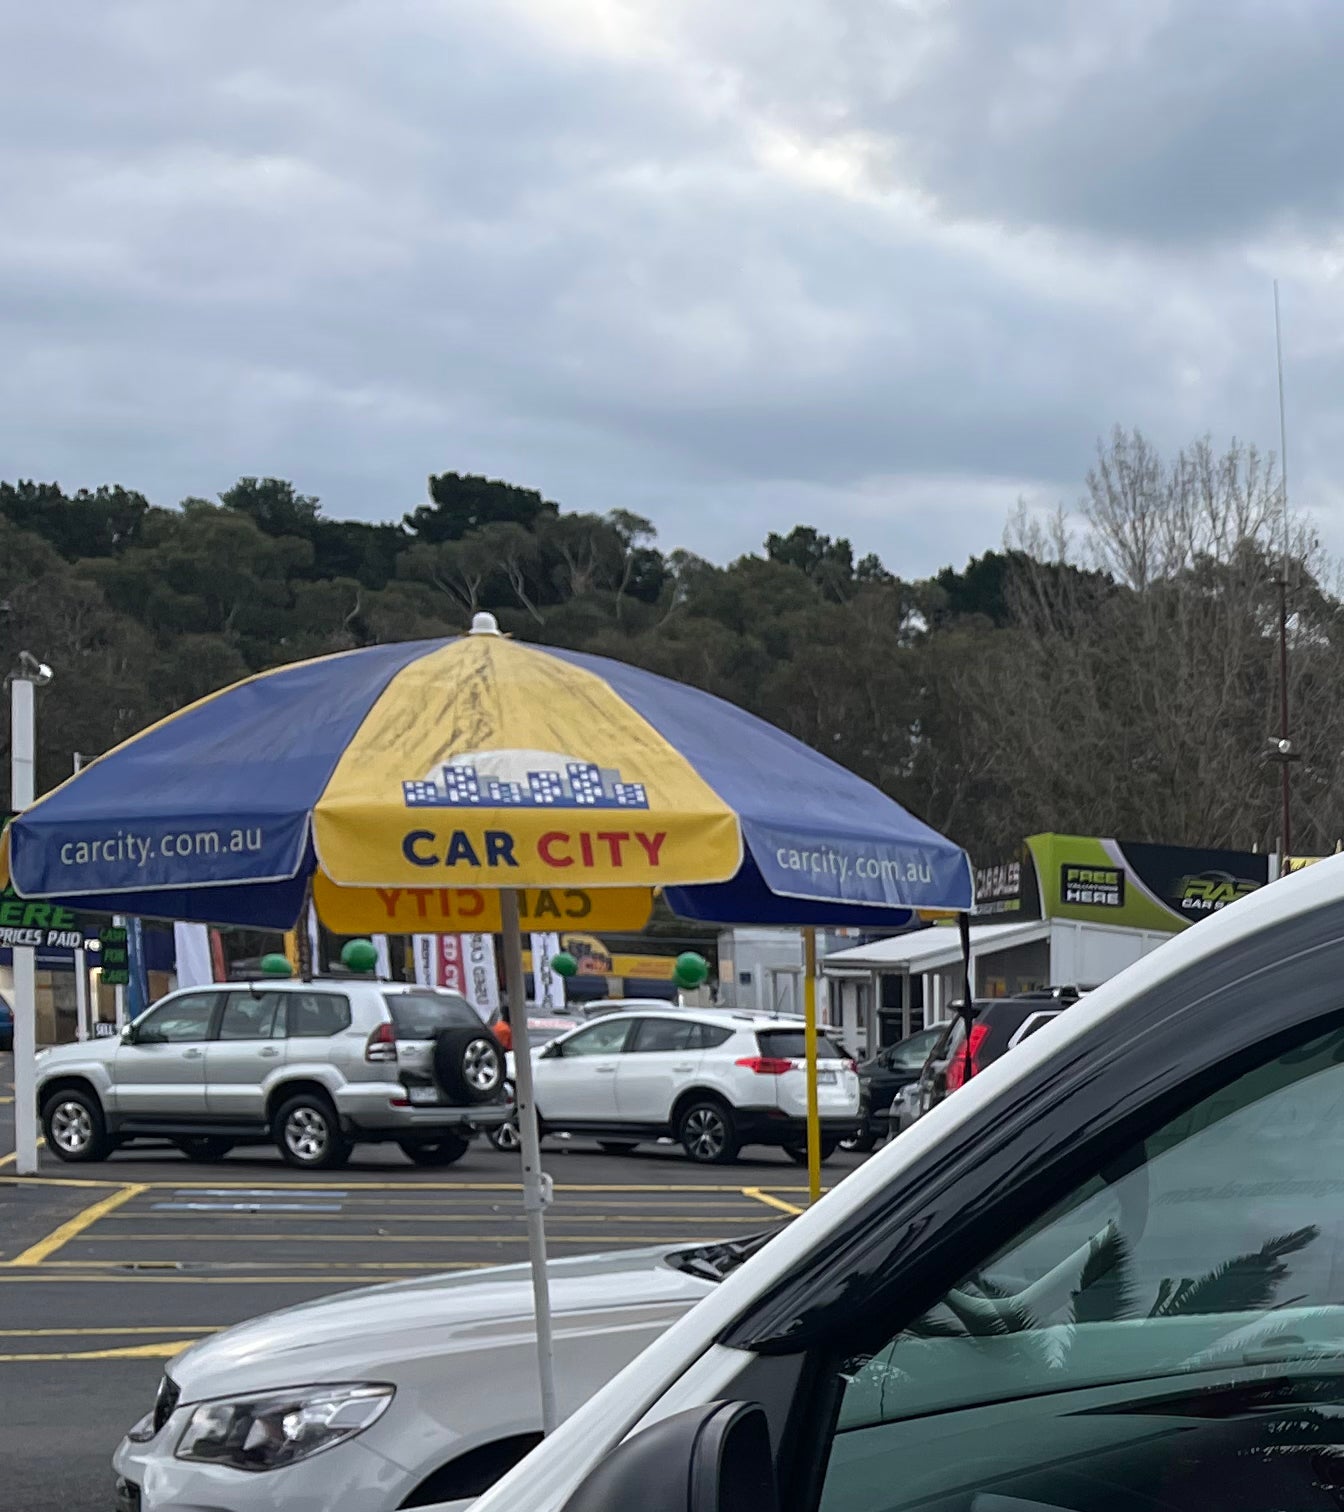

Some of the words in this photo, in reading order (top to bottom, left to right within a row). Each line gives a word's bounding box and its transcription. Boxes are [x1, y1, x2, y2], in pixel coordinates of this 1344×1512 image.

[60, 827, 262, 866] carcity.com.au
[402, 830, 519, 867] CAR
[537, 831, 667, 868] CITY
[776, 844, 932, 884] carcity.com.au
[1066, 890, 1119, 905] HERE
[47, 930, 81, 948] PAID
